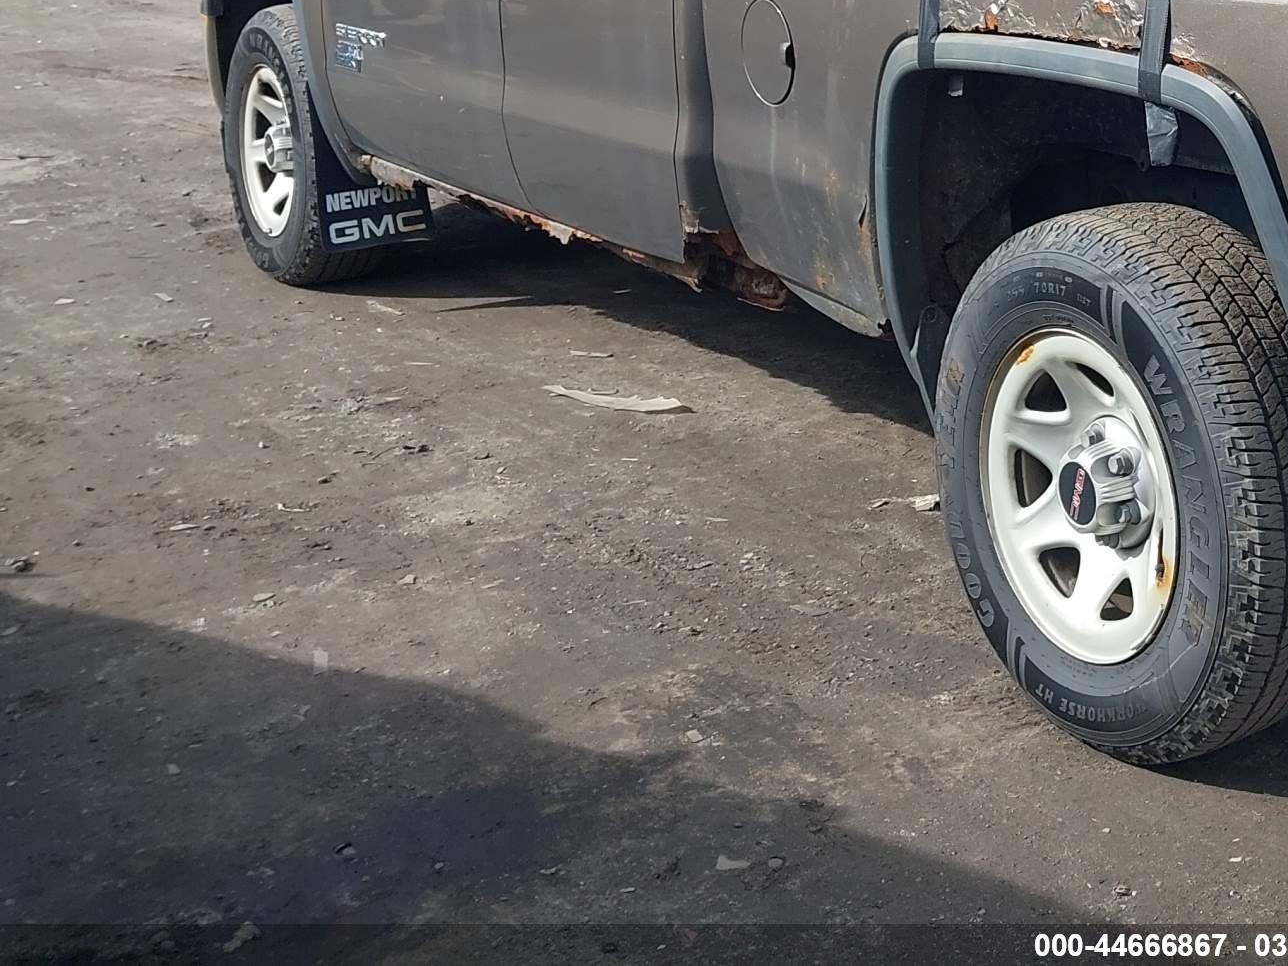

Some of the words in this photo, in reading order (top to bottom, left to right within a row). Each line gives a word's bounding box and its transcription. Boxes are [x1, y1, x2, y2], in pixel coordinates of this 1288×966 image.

[329, 209, 427, 244] GMC
[1066, 467, 1086, 521] GMC
[1143, 354, 1210, 647] WRANGLER
[1036, 683, 1056, 704] HT
